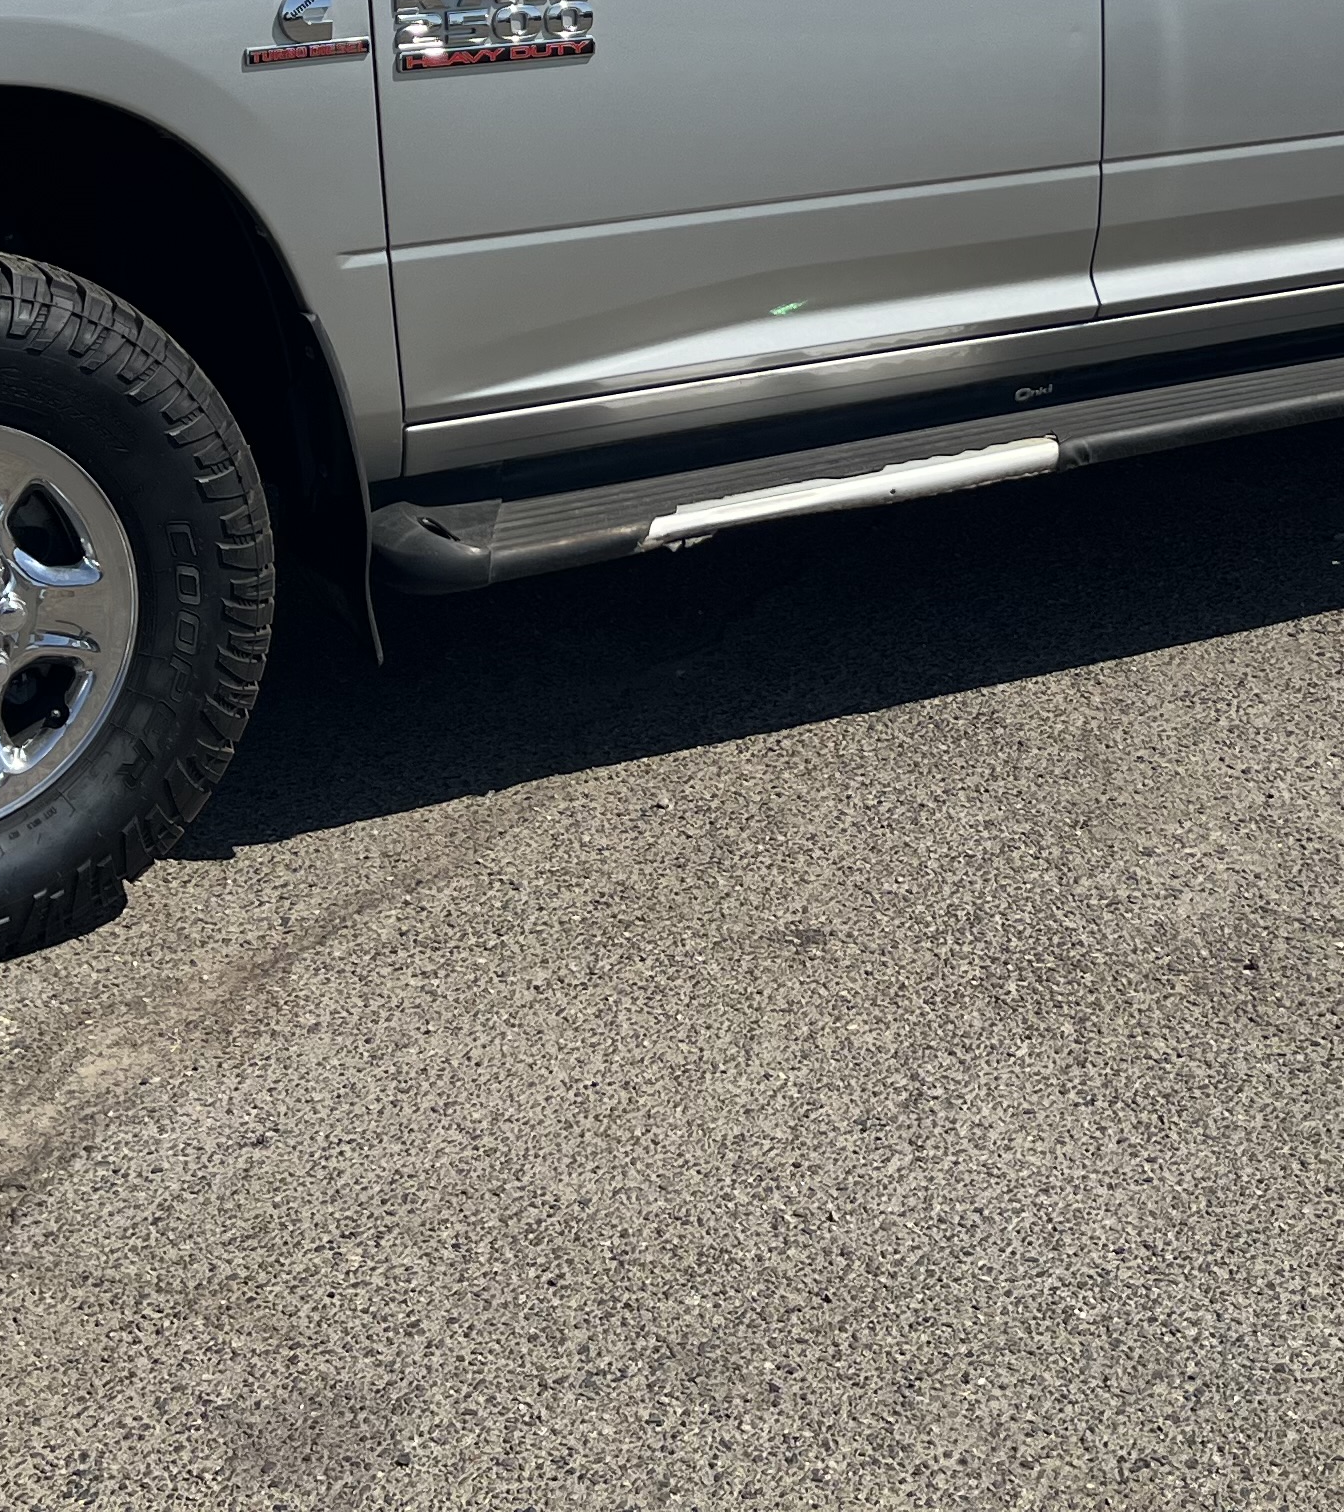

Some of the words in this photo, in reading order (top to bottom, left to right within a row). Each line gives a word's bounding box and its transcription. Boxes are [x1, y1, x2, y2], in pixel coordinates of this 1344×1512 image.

[394, 0, 594, 49] 2500
[250, 46, 307, 64] TURBO
[309, 40, 367, 58] DIESEL
[406, 48, 504, 68] HEAVY
[510, 40, 592, 61] DUTY
[117, 520, 202, 790] COOPER
